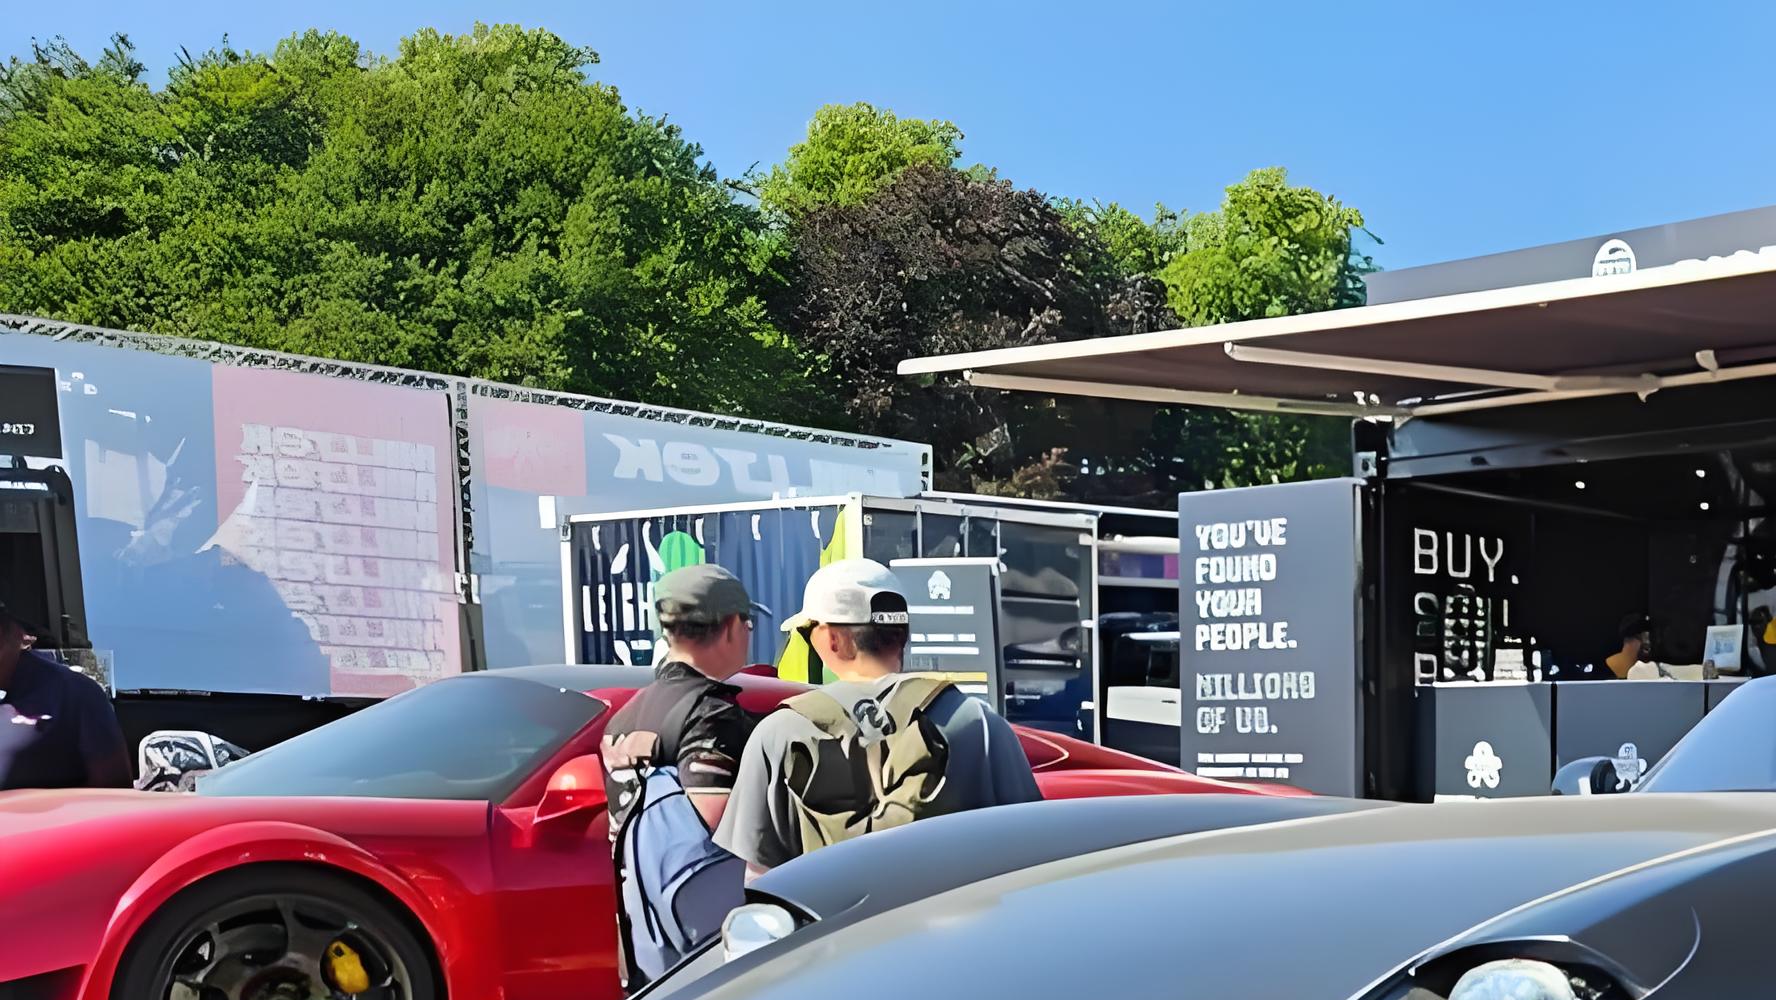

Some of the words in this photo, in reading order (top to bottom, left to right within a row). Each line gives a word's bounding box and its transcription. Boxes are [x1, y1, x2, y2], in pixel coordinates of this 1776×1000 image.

[1195, 517, 1288, 551] YOU'VE
[1413, 527, 1520, 585] BUY.
[1195, 621, 1298, 651] PEOPLE.
